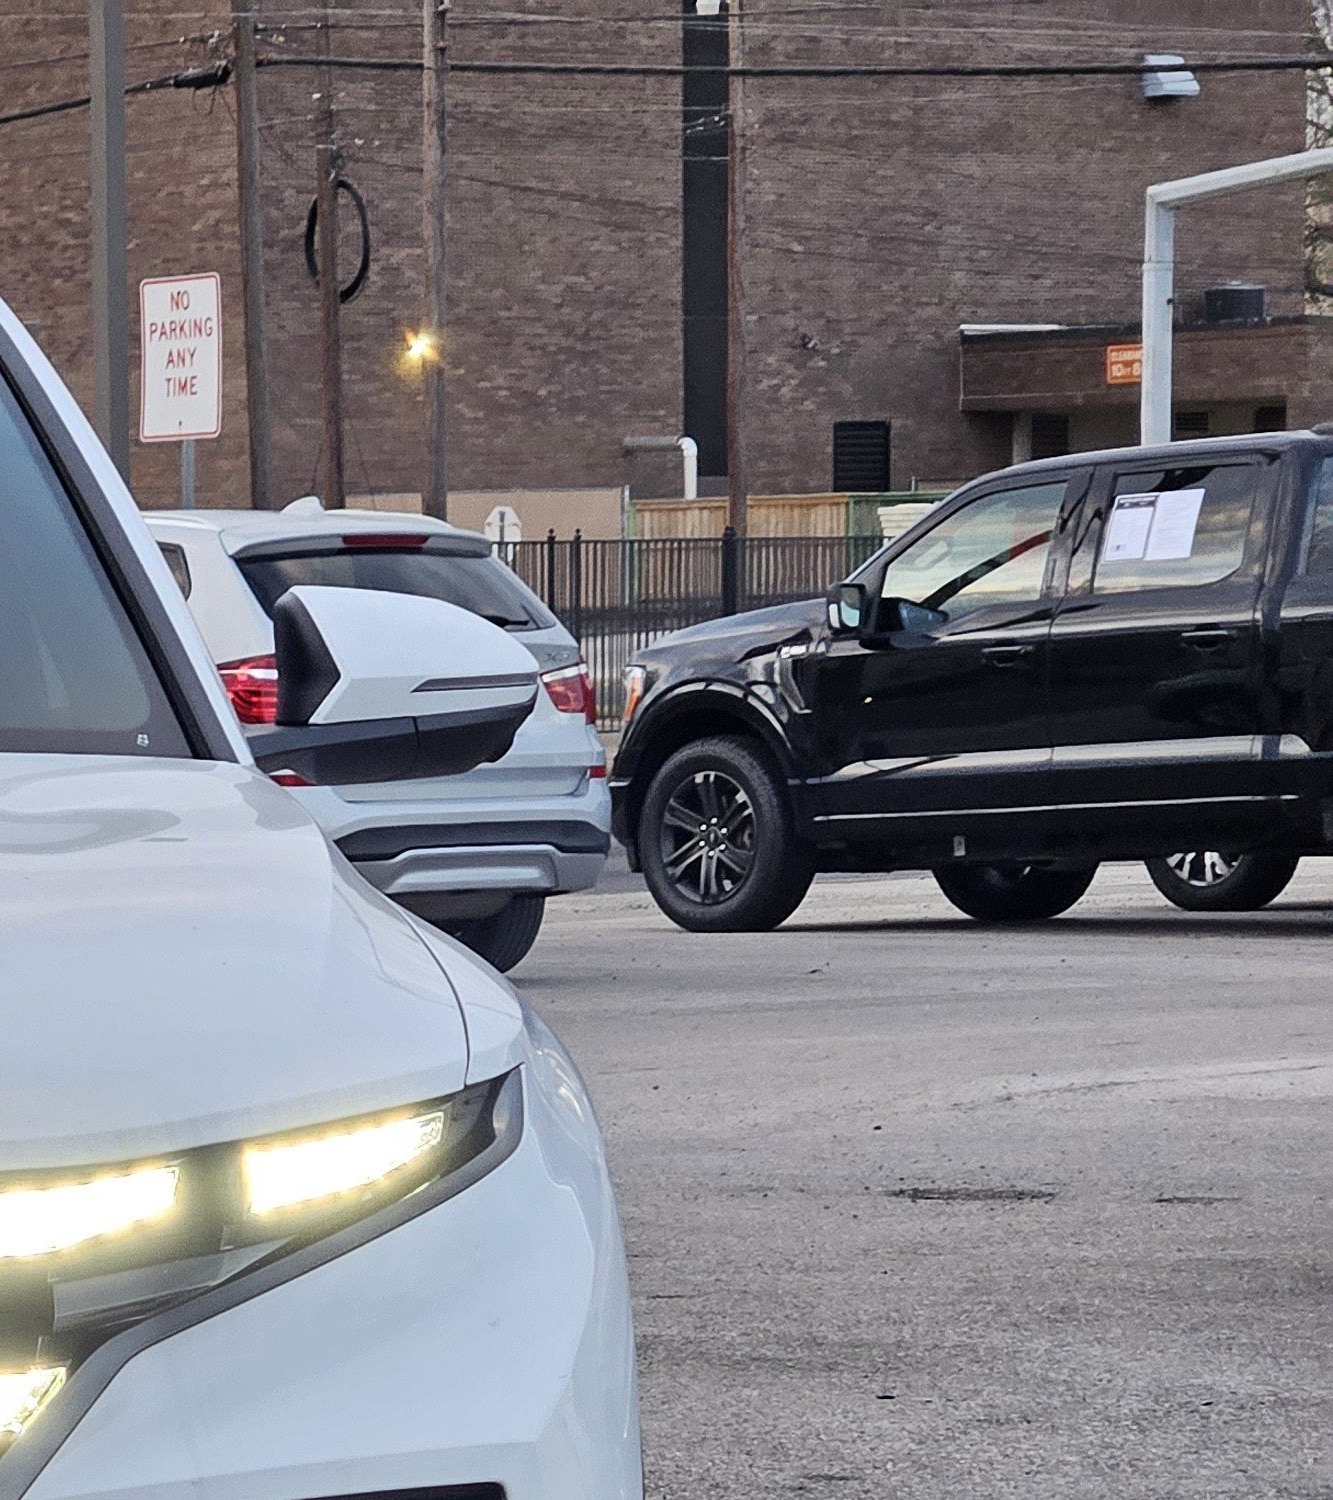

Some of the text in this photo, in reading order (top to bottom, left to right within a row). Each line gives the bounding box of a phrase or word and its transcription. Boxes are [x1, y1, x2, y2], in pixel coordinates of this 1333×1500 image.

[171, 291, 190, 311] NO
[149, 317, 213, 342] PARKING
[165, 347, 198, 370] ANY
[164, 375, 198, 398] TIME
